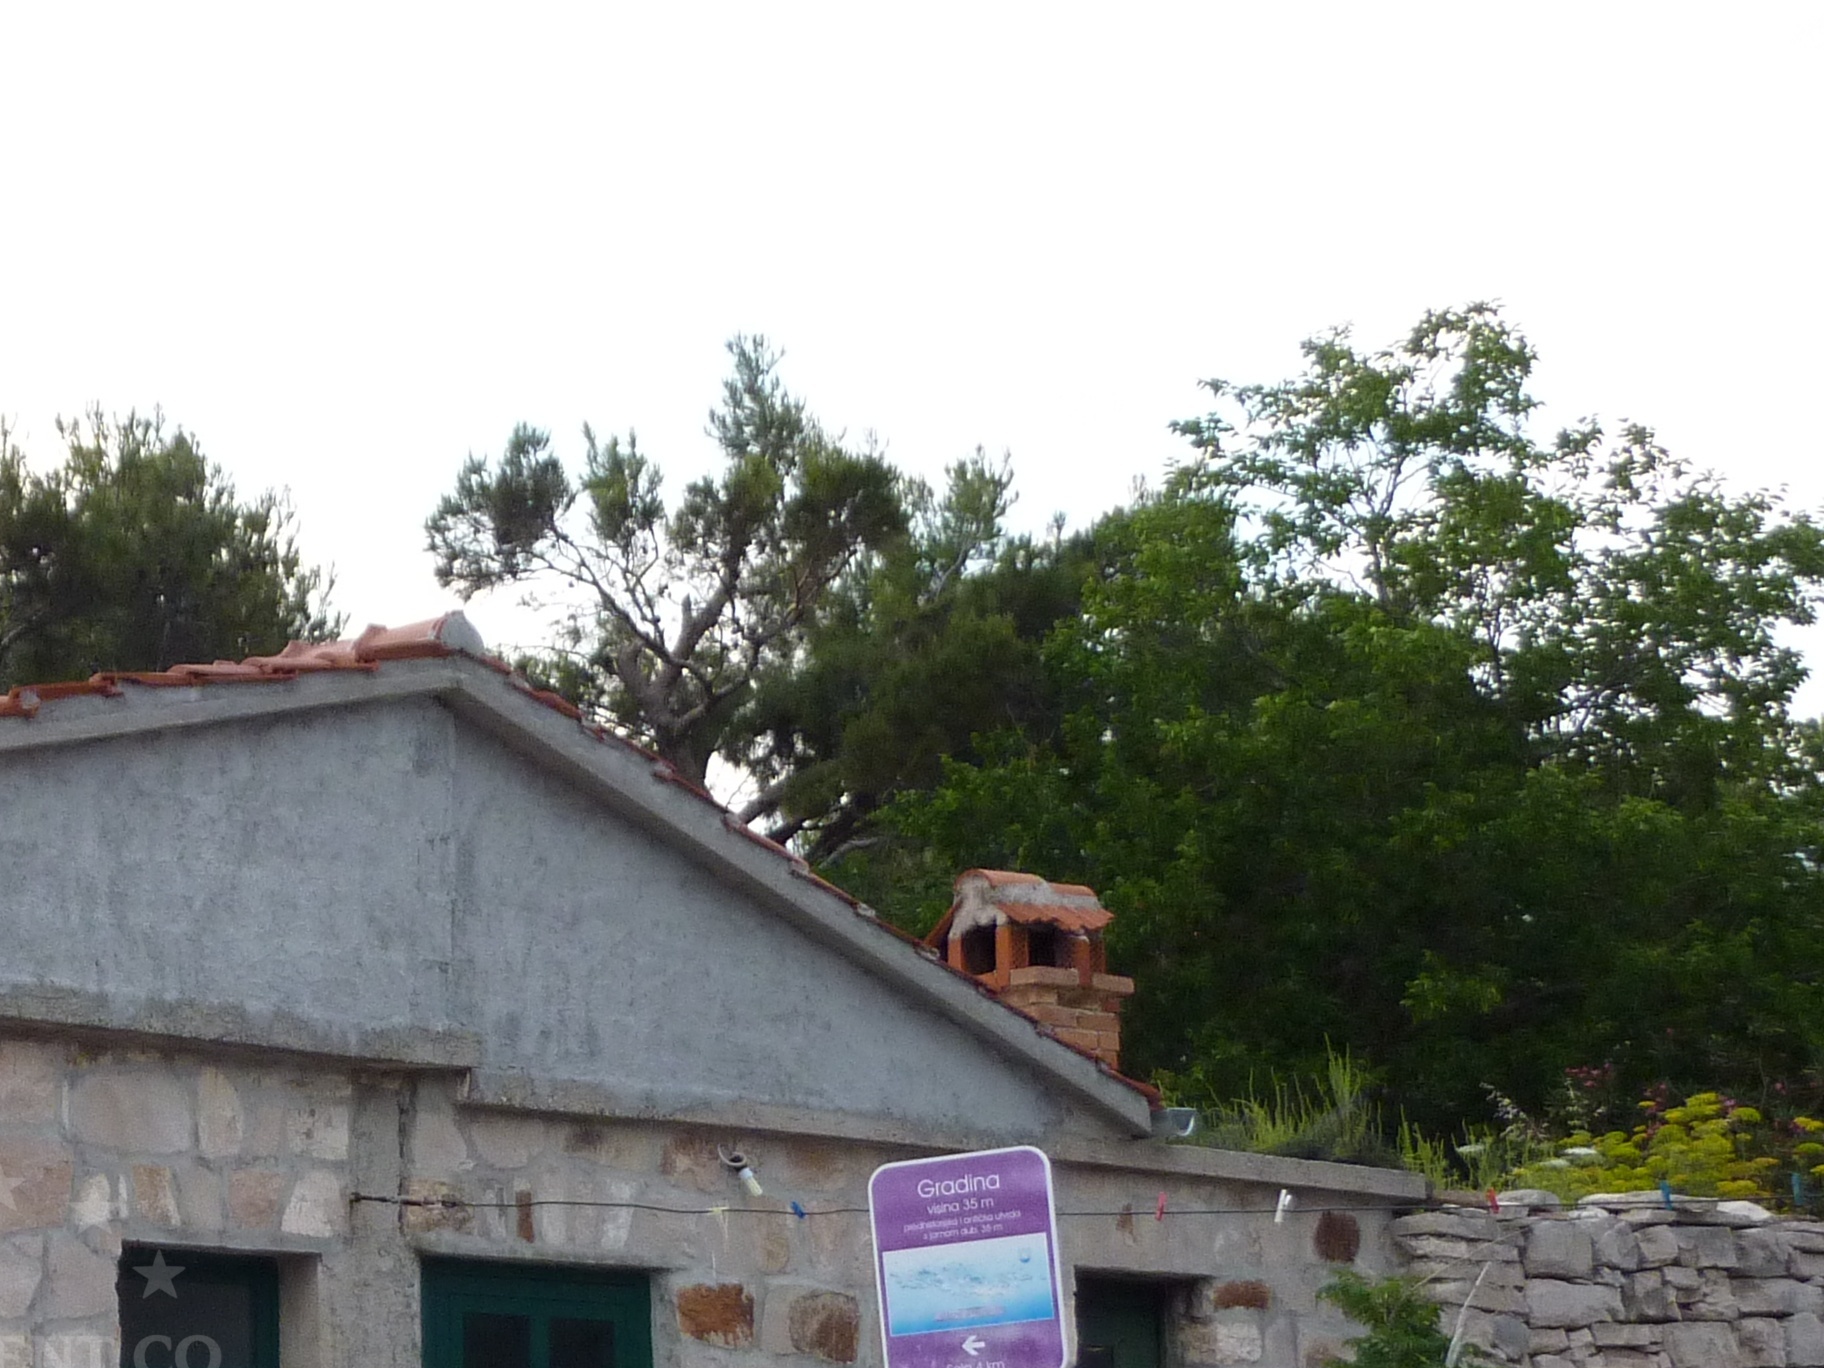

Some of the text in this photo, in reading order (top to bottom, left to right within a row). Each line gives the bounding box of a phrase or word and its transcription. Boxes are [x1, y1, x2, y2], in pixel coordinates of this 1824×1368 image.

[917, 1174, 1000, 1198] Gradina
[927, 1198, 994, 1214] visina 35 m
